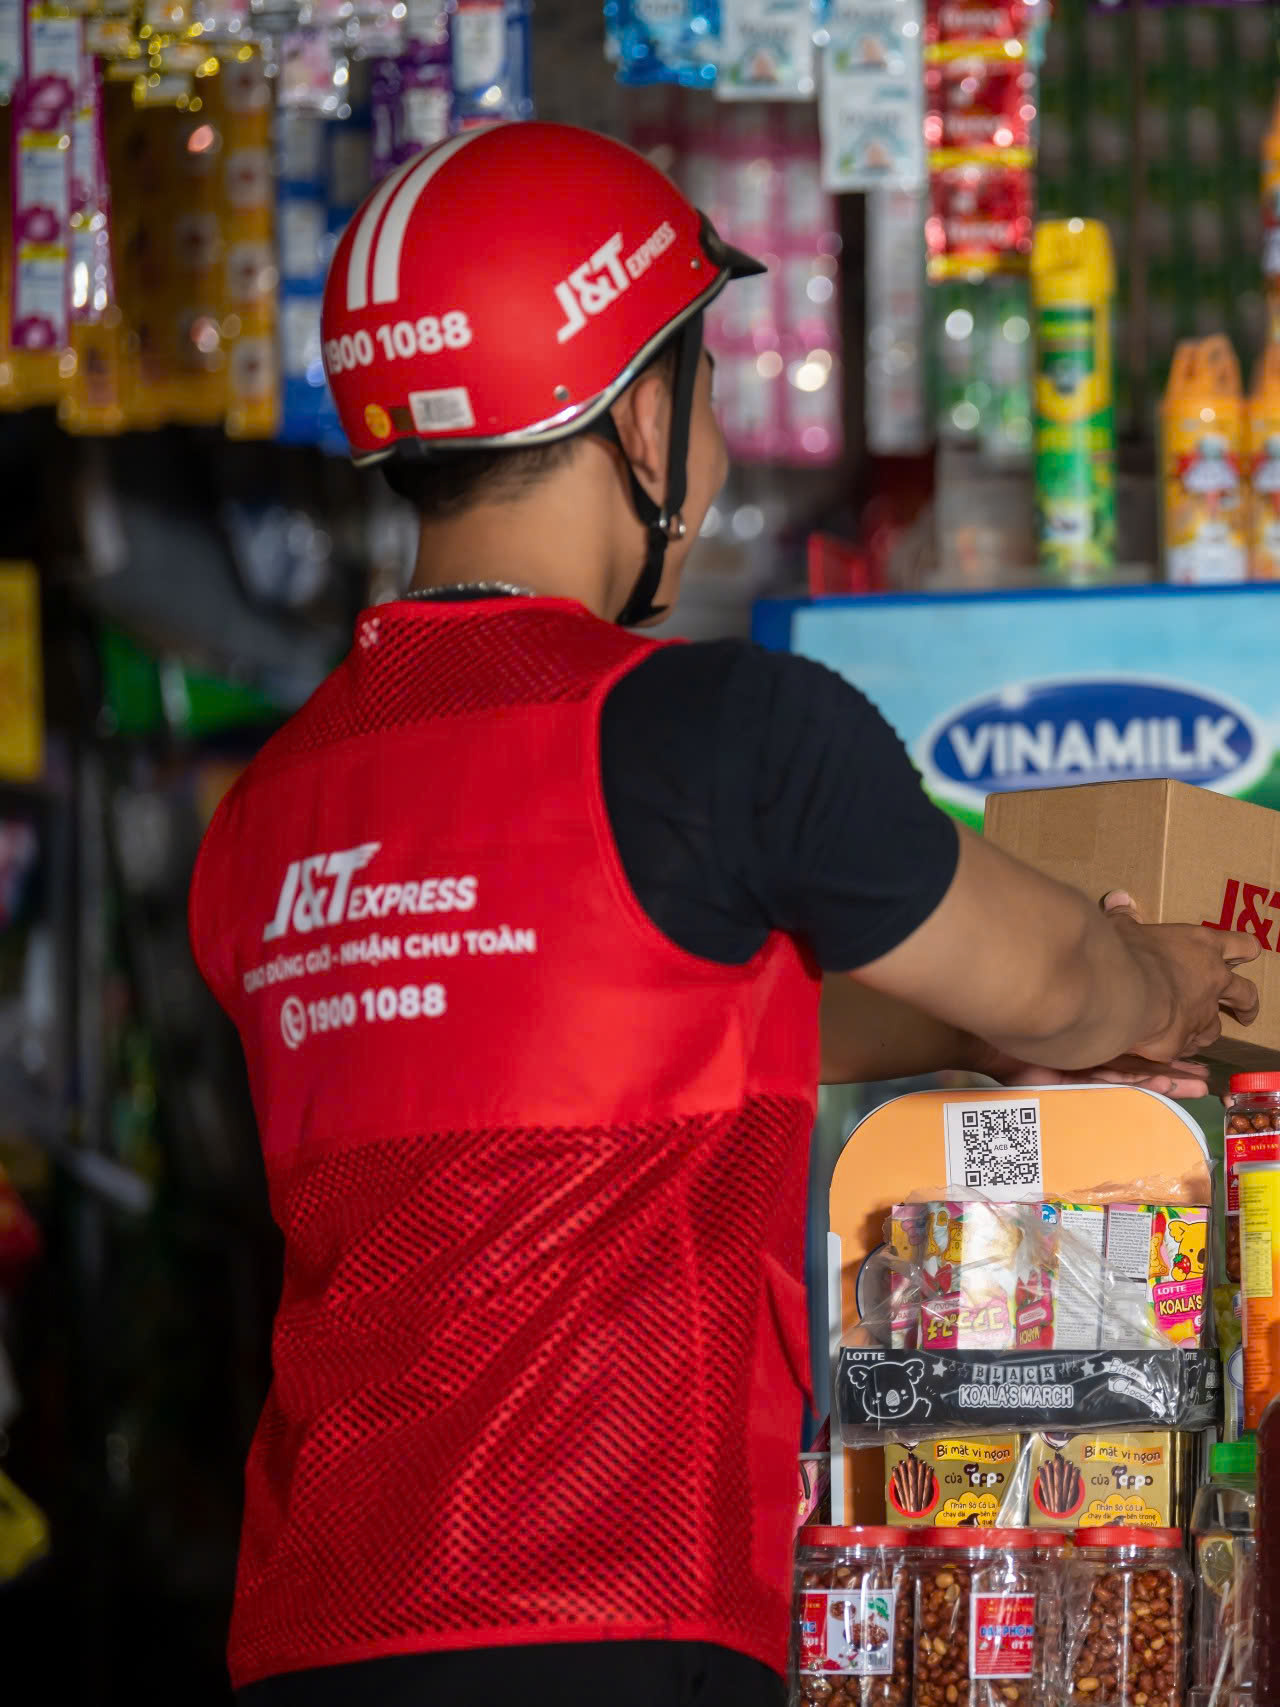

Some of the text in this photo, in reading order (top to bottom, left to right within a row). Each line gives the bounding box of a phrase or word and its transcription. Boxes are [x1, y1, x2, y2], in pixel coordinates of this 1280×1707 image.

[554, 220, 677, 344] J&T EXPRESS
[376, 310, 473, 361] 1088
[949, 715, 1240, 779] VINAMILK
[262, 841, 477, 942] J&T EXPRESS
[404, 932, 458, 958] CHU
[463, 924, 537, 955] TOÀN
[308, 983, 447, 1035] 1900 1088
[1157, 1284, 1187, 1295] LOTTE
[1159, 1295, 1204, 1316] KOALA'S
[846, 1352, 885, 1361] LOTTE
[976, 1365, 1053, 1380] BLACK
[959, 1384, 1074, 1408] KOALA'S MARCH
[936, 1444, 948, 1457] Bí
[950, 1445, 970, 1457] mật
[984, 1449, 1010, 1461] ngon
[1085, 1445, 1096, 1458] Bí
[1099, 1446, 1118, 1458] mật
[1133, 1452, 1161, 1464] ngon
[944, 1472, 963, 1484] của
[1090, 1474, 1110, 1486] của
